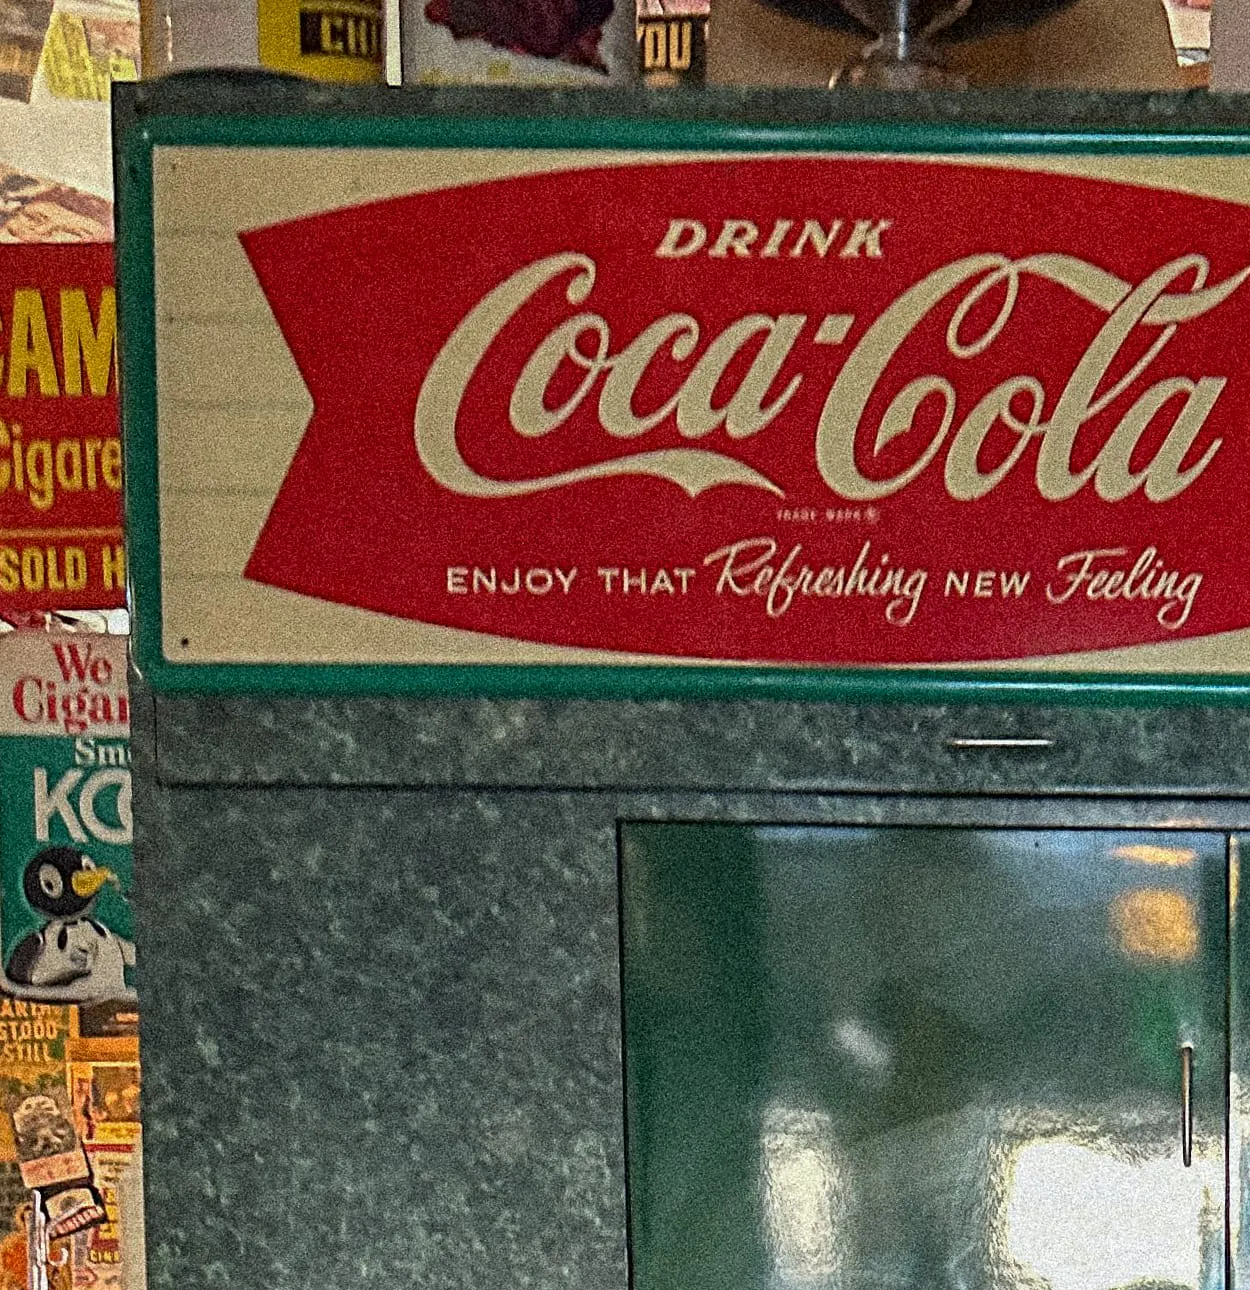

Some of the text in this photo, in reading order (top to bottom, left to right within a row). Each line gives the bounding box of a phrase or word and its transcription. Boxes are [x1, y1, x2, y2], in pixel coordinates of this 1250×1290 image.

[655, 218, 893, 259] DRINK
[0, 286, 118, 398] AM
[0, 546, 88, 591] SOLD
[446, 536, 1204, 630] ENJOY THAT Refreshing NEW Feeling
[52, 642, 113, 684] We
[75, 738, 131, 767] Sm
[34, 767, 134, 845] KO
